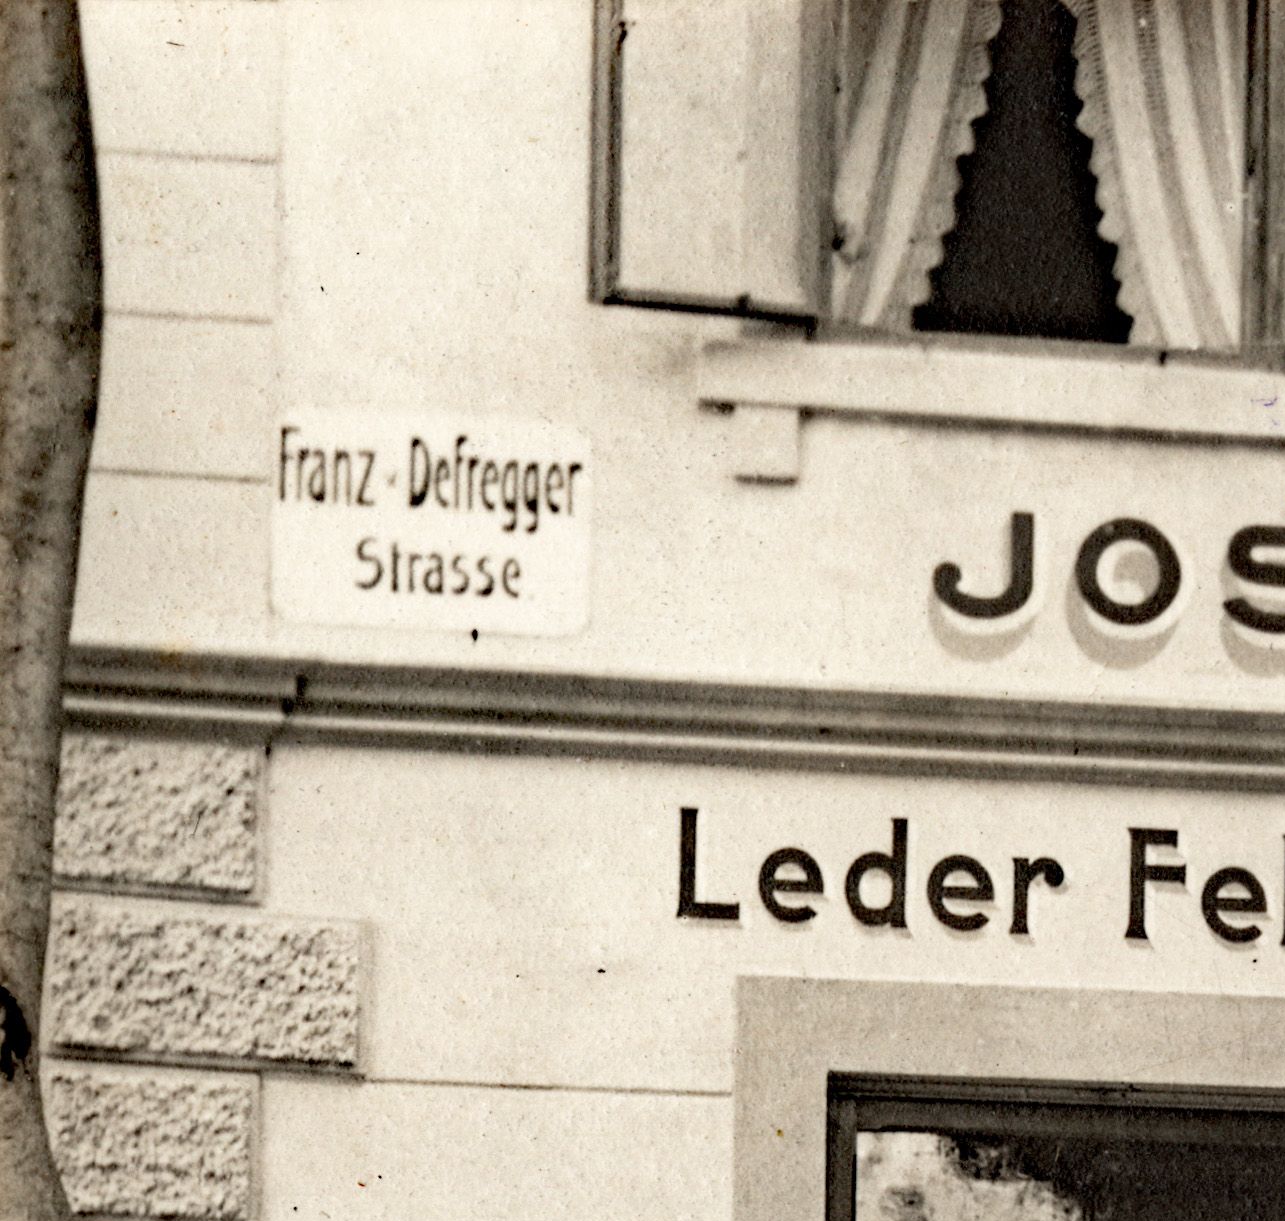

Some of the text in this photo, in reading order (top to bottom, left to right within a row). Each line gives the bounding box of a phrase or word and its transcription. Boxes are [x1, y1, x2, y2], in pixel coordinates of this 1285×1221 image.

[408, 434, 584, 534] Defregger
[354, 536, 522, 600] Strasse
[676, 806, 1065, 935] Leder
